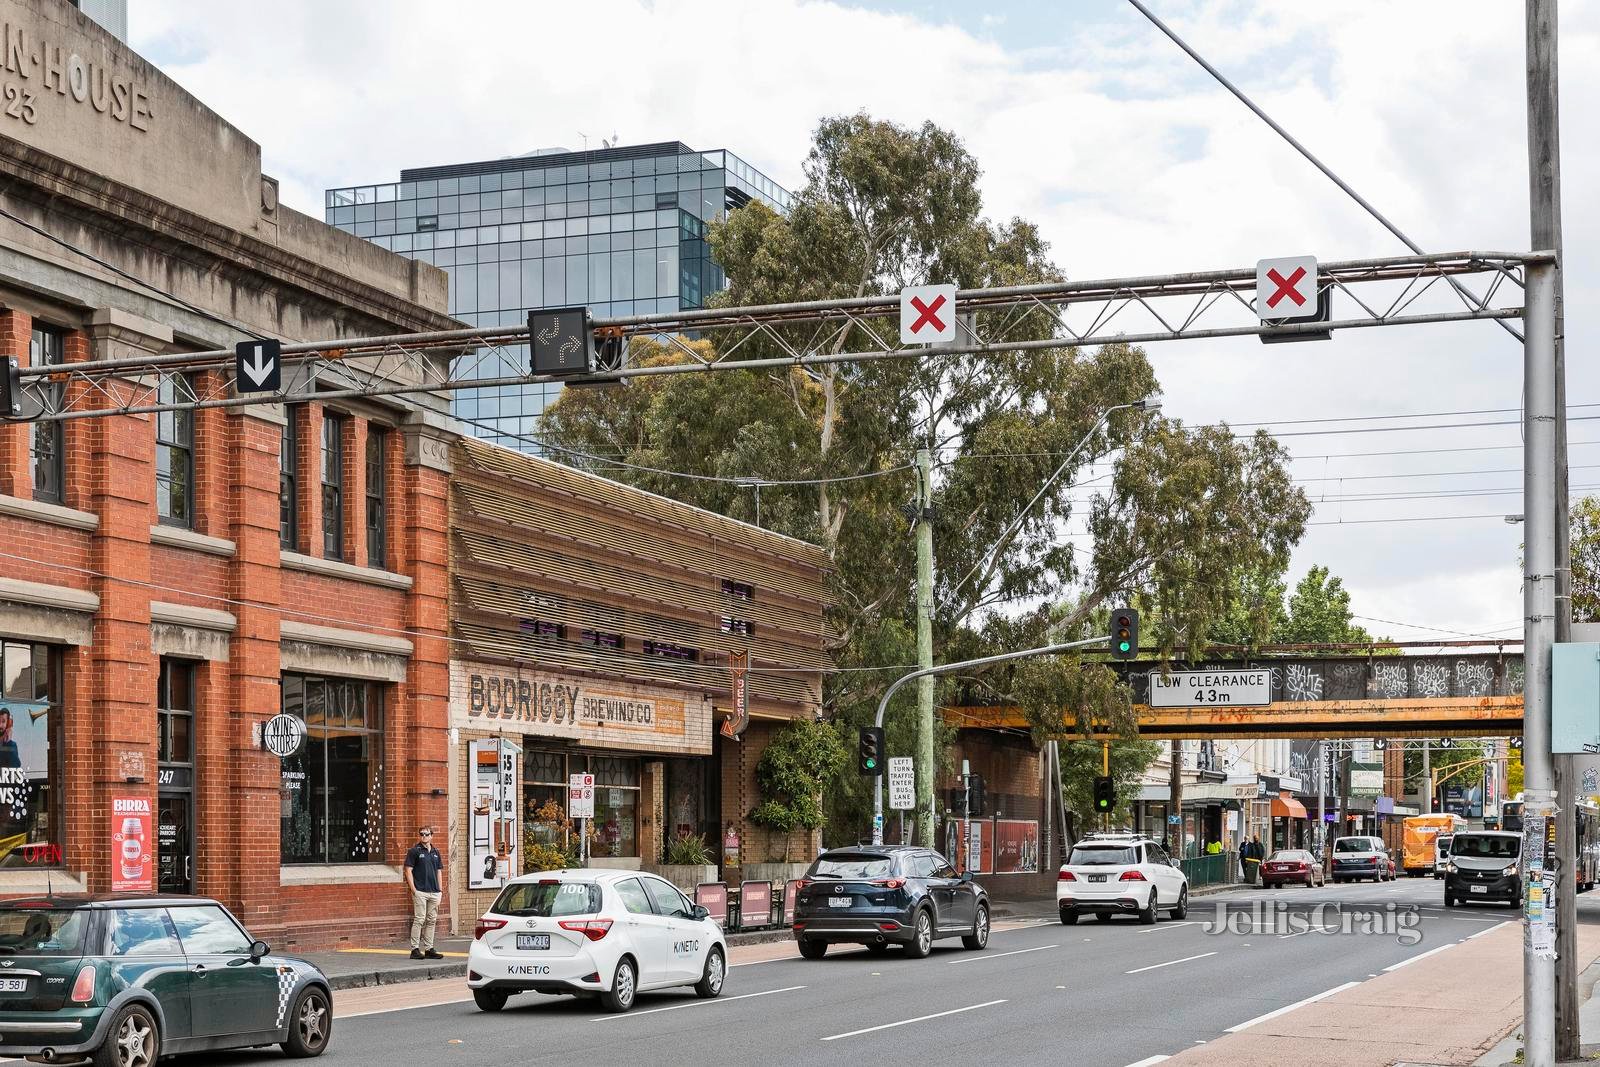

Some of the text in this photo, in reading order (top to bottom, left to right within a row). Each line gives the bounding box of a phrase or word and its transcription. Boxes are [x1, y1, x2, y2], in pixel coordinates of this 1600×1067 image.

[1156, 674, 1264, 688] LOW CLEARANCE
[469, 674, 653, 725] BODRIGGY BREWING CO.
[272, 716, 294, 736] WINE
[270, 734, 295, 753] STORE
[0, 767, 24, 784] RTS
[159, 770, 175, 784] 247
[114, 799, 150, 812] BIRRA
[24, 843, 63, 864] OPEN
[561, 883, 585, 895] 100
